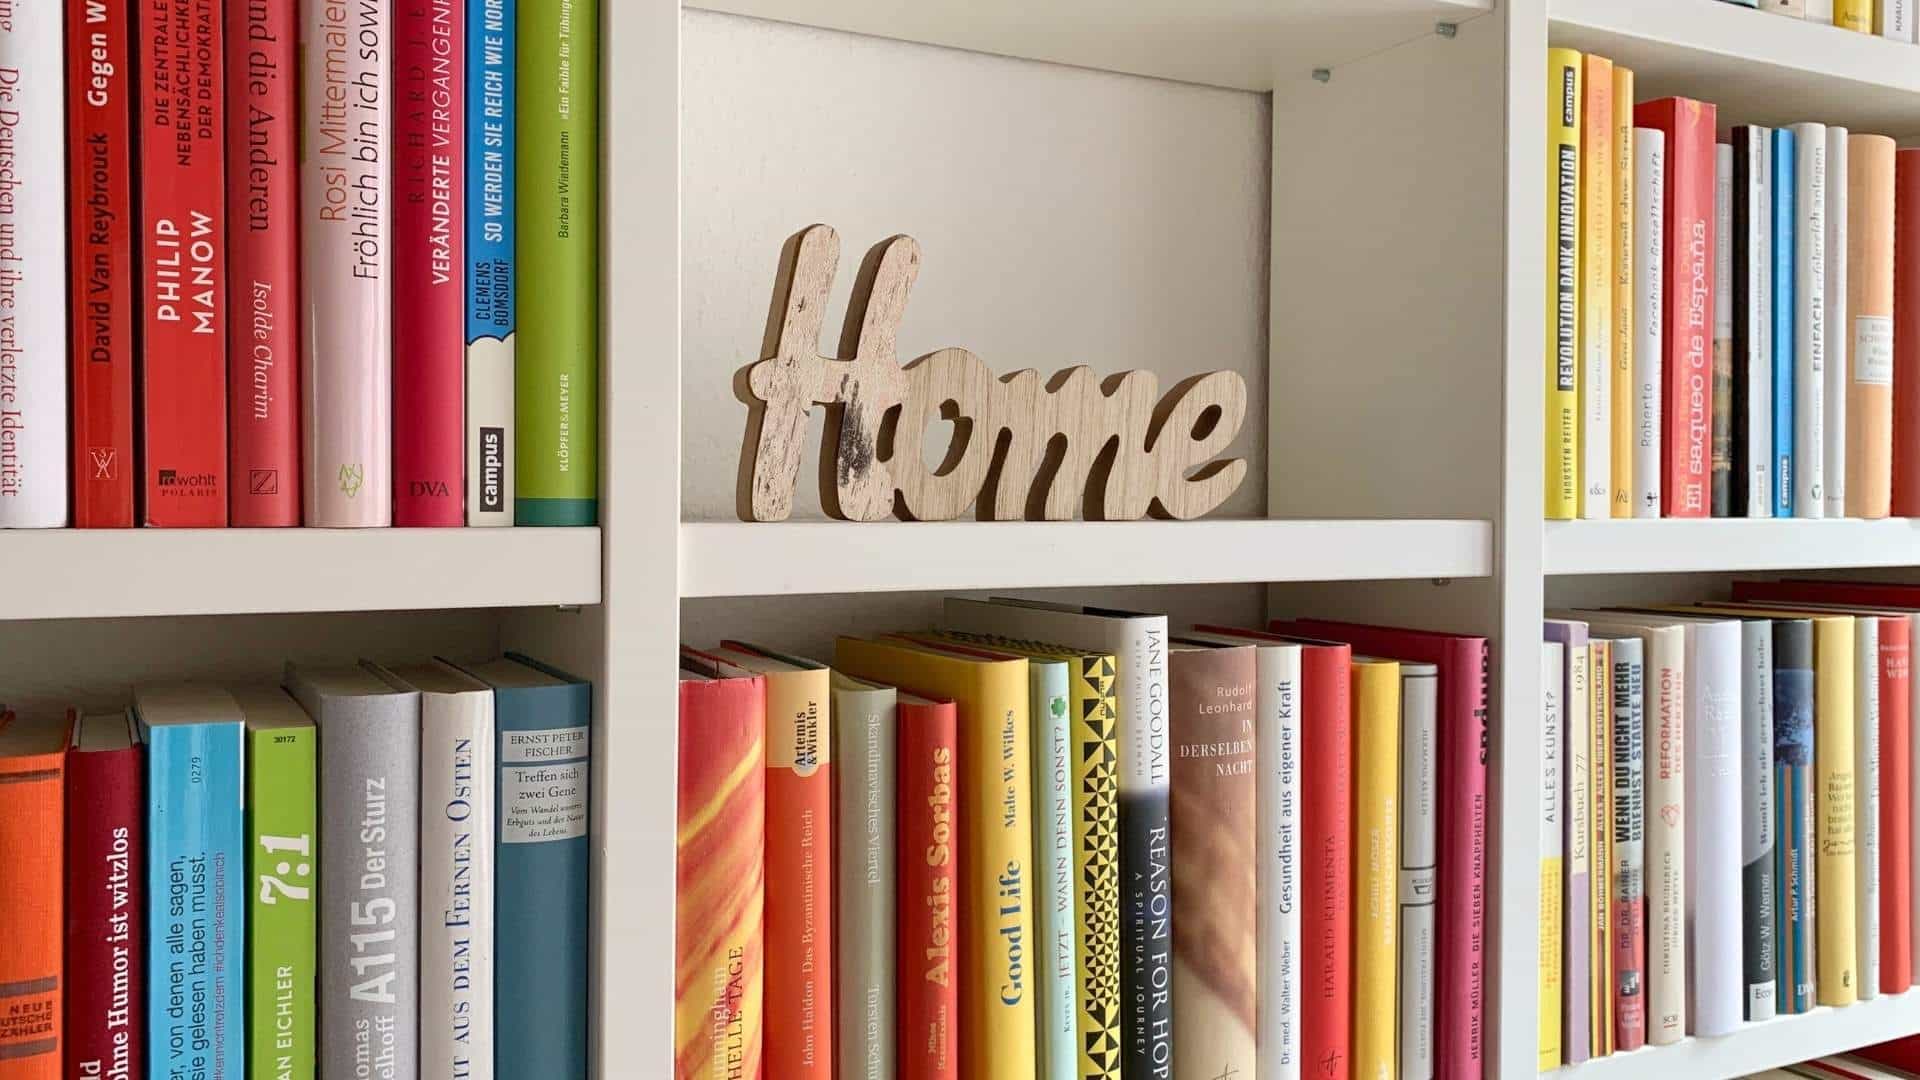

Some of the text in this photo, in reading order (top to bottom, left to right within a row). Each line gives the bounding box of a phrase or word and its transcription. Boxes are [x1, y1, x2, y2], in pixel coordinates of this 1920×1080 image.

[88, 33, 114, 106] Gegen
[154, 1, 170, 125] DIE ZENTRALE
[1564, 70, 1575, 123] campus
[198, 105, 213, 139] DER
[249, 52, 277, 232] die Anderen
[408, 65, 425, 203] RICHARD
[484, 36, 503, 242] SO WERDEN SIE REICH WIE
[558, 131, 569, 193] Wiedemann
[319, 167, 346, 221] Rosi
[352, 72, 379, 279] Fröhlich bin ich
[89, 132, 115, 363] David Van Reybrouck
[428, 156, 450, 284] VERÄNDERTE
[558, 197, 569, 238] Barbara
[1649, 152, 1661, 337] Facebook-Gesellschaft
[0, 68, 24, 497] Die Deutschen und ihre verletzte Identität
[156, 219, 181, 320] PHILIP
[191, 211, 214, 334] MANOW
[476, 262, 490, 320] CLEMENS
[493, 259, 509, 326] BOMSDORF
[1559, 149, 1576, 386] REVOLUTION DANK INNOVATION
[254, 281, 273, 420] Isolde Charim
[733, 223, 1247, 522] Home
[1686, 220, 1708, 511] El saqueo de España
[1813, 297, 1822, 371] EINFACH
[1641, 383, 1652, 447] Roberto
[409, 480, 449, 496] DVA
[485, 434, 502, 505] campus
[1146, 630, 1164, 785] JANE GOODALL
[1199, 700, 1253, 715] Leonhard
[1216, 683, 1253, 698] Rudolf
[1573, 655, 1585, 692] 1984
[511, 732, 585, 745] ERNST PETER
[525, 746, 573, 758] FISCHER
[795, 712, 805, 766] Artemis
[806, 701, 817, 756] Winkler
[1180, 740, 1254, 759] DERSELBEN
[1241, 719, 1253, 733] IN
[1545, 691, 1557, 823] ALLES KUNST?
[1615, 662, 1630, 843] WENN DU NICHT MEHR
[1632, 663, 1641, 841] BRENNST STARTE NEU
[1660, 667, 1673, 780] REFORMATION
[191, 757, 202, 784] 0279
[513, 768, 580, 783] Treffen sich
[519, 786, 577, 800] zwei Gene
[866, 713, 881, 885] Skandinavisches Viertel
[1001, 709, 1016, 828] Malte W. Wilkes
[1216, 760, 1254, 777] NACHT
[1277, 680, 1295, 915] Gesundheit aus eigener Kraft
[1054, 726, 1071, 978] JETZT WANN DENN SONST?
[1572, 781, 1585, 861] Kursbuch
[259, 834, 310, 904] 7:1
[350, 777, 396, 1003] A115 Der Sturz
[926, 747, 951, 987] Alexis Sorbas
[1620, 859, 1630, 903] RAINER
[1790, 848, 1800, 921] Artur Schmidt
[107, 827, 129, 1029] Humor ist witzlos
[167, 856, 188, 1058] von denen alle sagen,
[801, 810, 817, 1067] John Haldon Das Byzantinische Reich
[998, 861, 1023, 1006] Good Life
[1150, 827, 1168, 1012] REASON FOR
[1469, 793, 1483, 1061] HENRIK MÜLLER DIE SIEBEN KNAPPHEITEN
[1759, 943, 1771, 970] Götz
[1760, 921, 1770, 938] W.
[189, 918, 209, 1080] sie gelesen haben
[452, 940, 471, 990] DEM
[727, 946, 743, 1002] TAGE
[1135, 872, 1145, 1057] A SPIRITUAL JOURNEY
[1281, 941, 1292, 1065] Dr. med. Walter Weber
[1323, 928, 1336, 999] HARALD
[277, 966, 293, 1048] EICHLER
[452, 1002, 471, 1044] AUS
[867, 984, 881, 1040] Torsten
